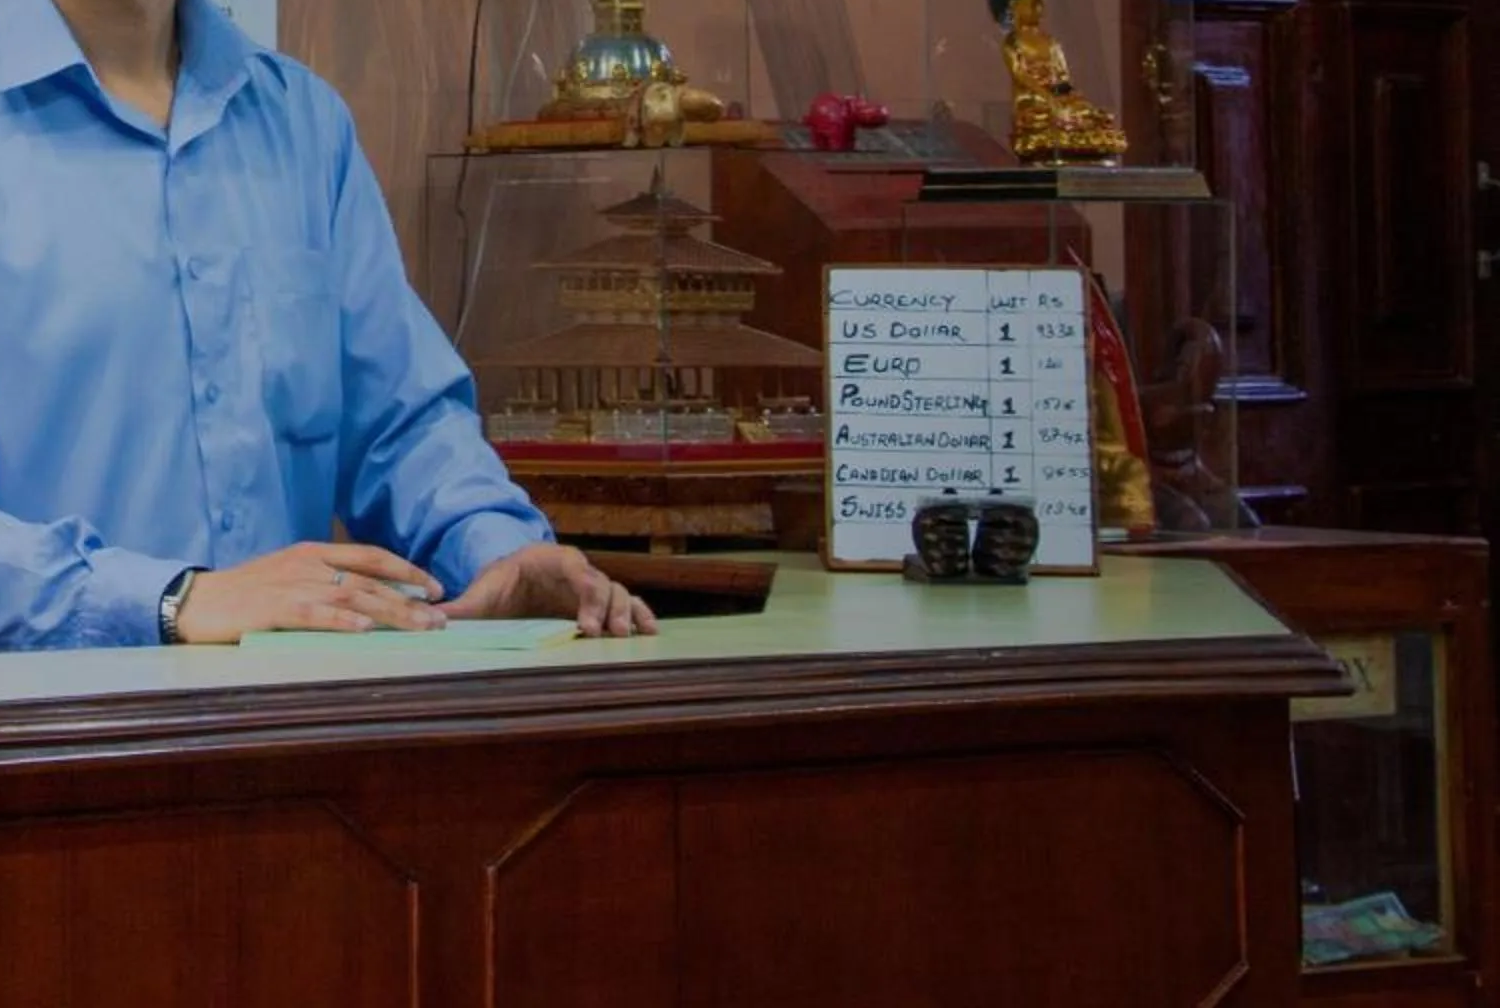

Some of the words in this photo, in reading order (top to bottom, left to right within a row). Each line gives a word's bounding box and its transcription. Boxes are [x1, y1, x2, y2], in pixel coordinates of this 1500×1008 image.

[829, 290, 956, 312] CURRENCY
[843, 320, 877, 339] US
[999, 322, 1017, 341] 1
[844, 353, 921, 379] EURO
[1000, 356, 1016, 374] 1
[1002, 397, 1017, 415] 1
[1002, 431, 1015, 448] 1
[1003, 465, 1020, 483] 1
[840, 495, 907, 518] SWISS
